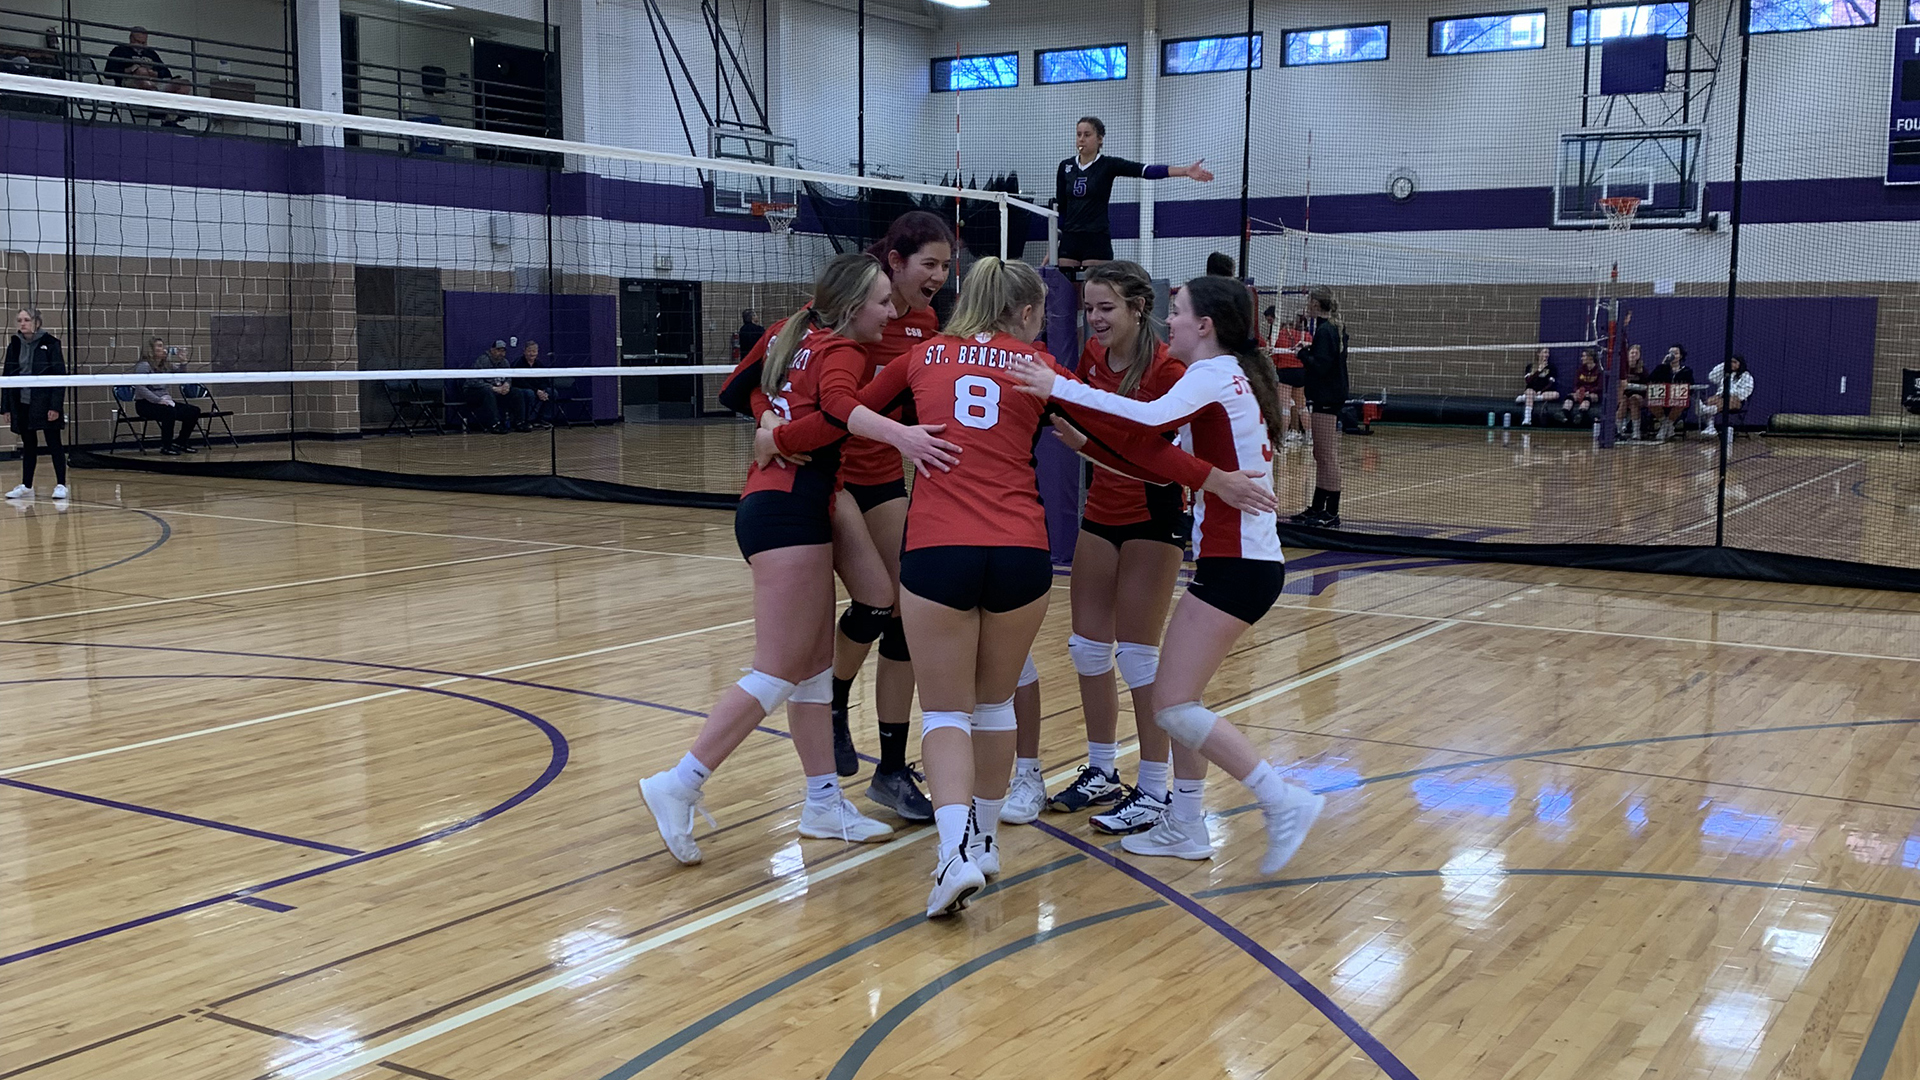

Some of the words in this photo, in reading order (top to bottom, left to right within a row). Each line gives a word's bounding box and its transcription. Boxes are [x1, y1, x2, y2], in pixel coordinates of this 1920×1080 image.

[1073, 177, 1087, 197] 5
[905, 327, 922, 337] CSB
[925, 345, 949, 365] ST.
[1650, 387, 1665, 398] 12
[1672, 387, 1688, 398] 12
[954, 374, 1000, 429] 8
